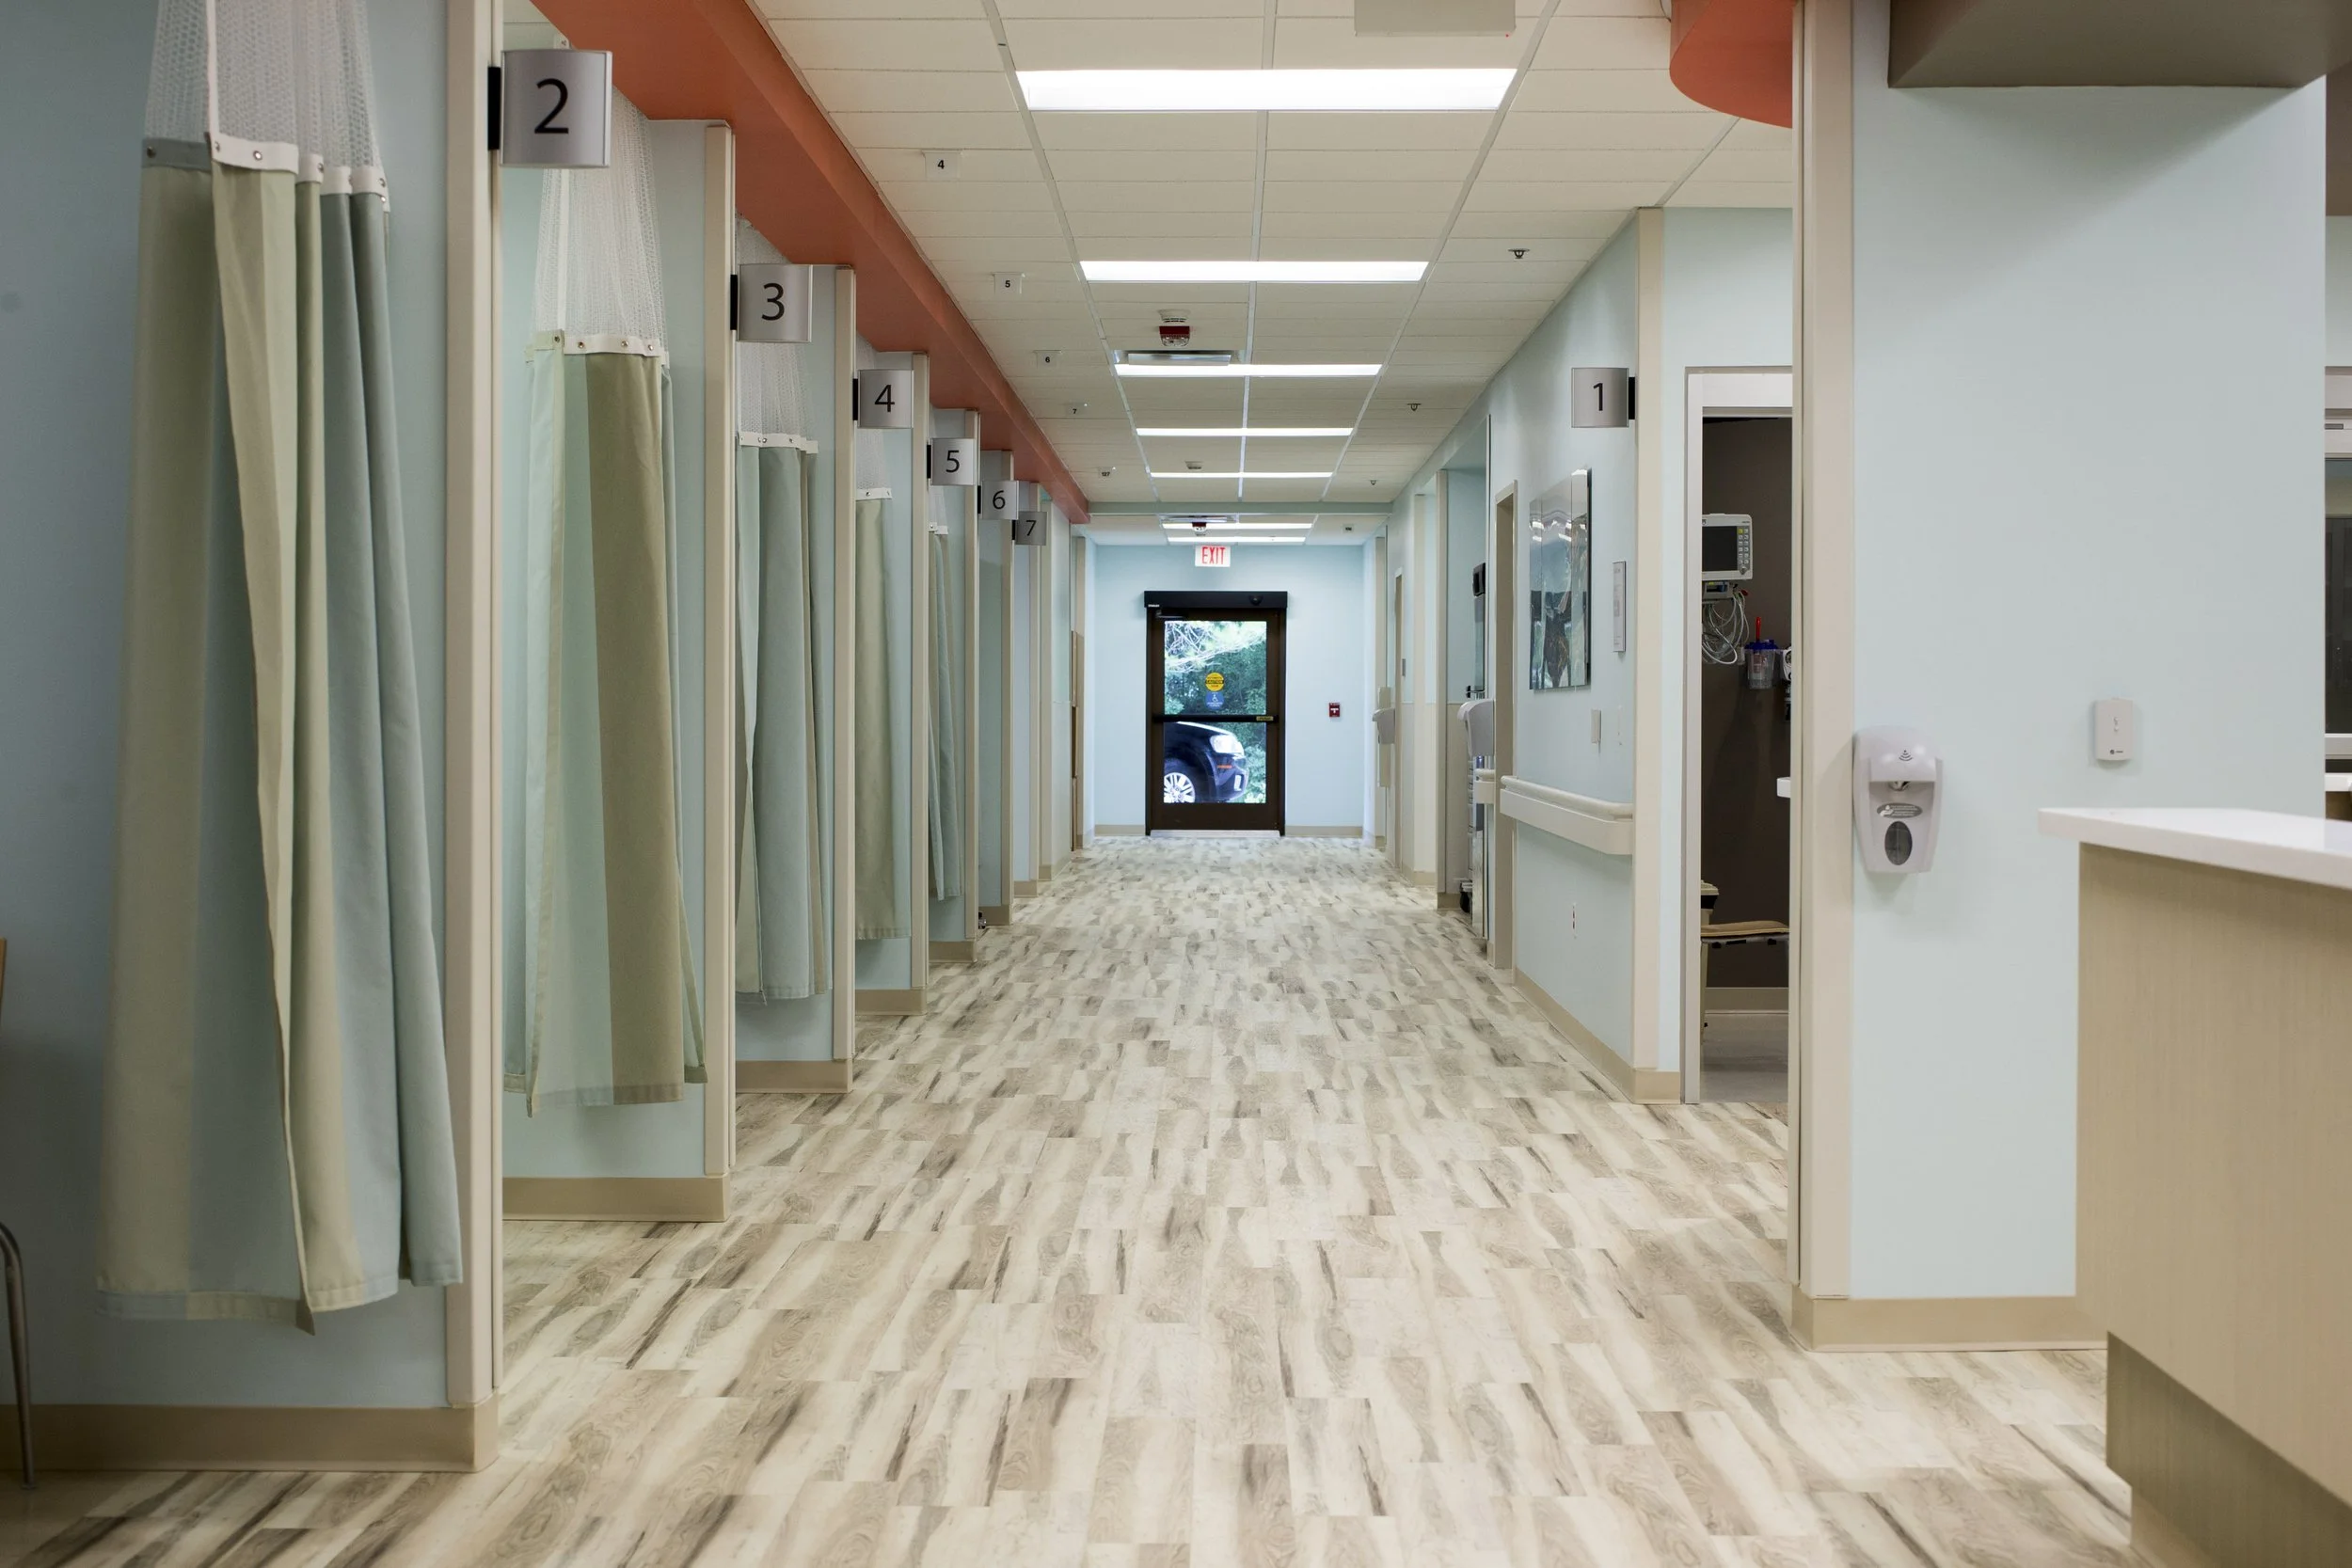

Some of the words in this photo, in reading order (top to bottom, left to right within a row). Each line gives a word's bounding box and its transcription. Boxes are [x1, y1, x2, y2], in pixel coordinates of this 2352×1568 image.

[534, 78, 568, 134] 2
[937, 160, 945, 169] 4
[761, 283, 785, 321] 3
[874, 384, 895, 412] 4
[1593, 383, 1603, 411] 1
[946, 450, 959, 472] 5
[992, 490, 1006, 510] 6
[1025, 520, 1036, 536] 7
[1201, 546, 1226, 564] EXIT
